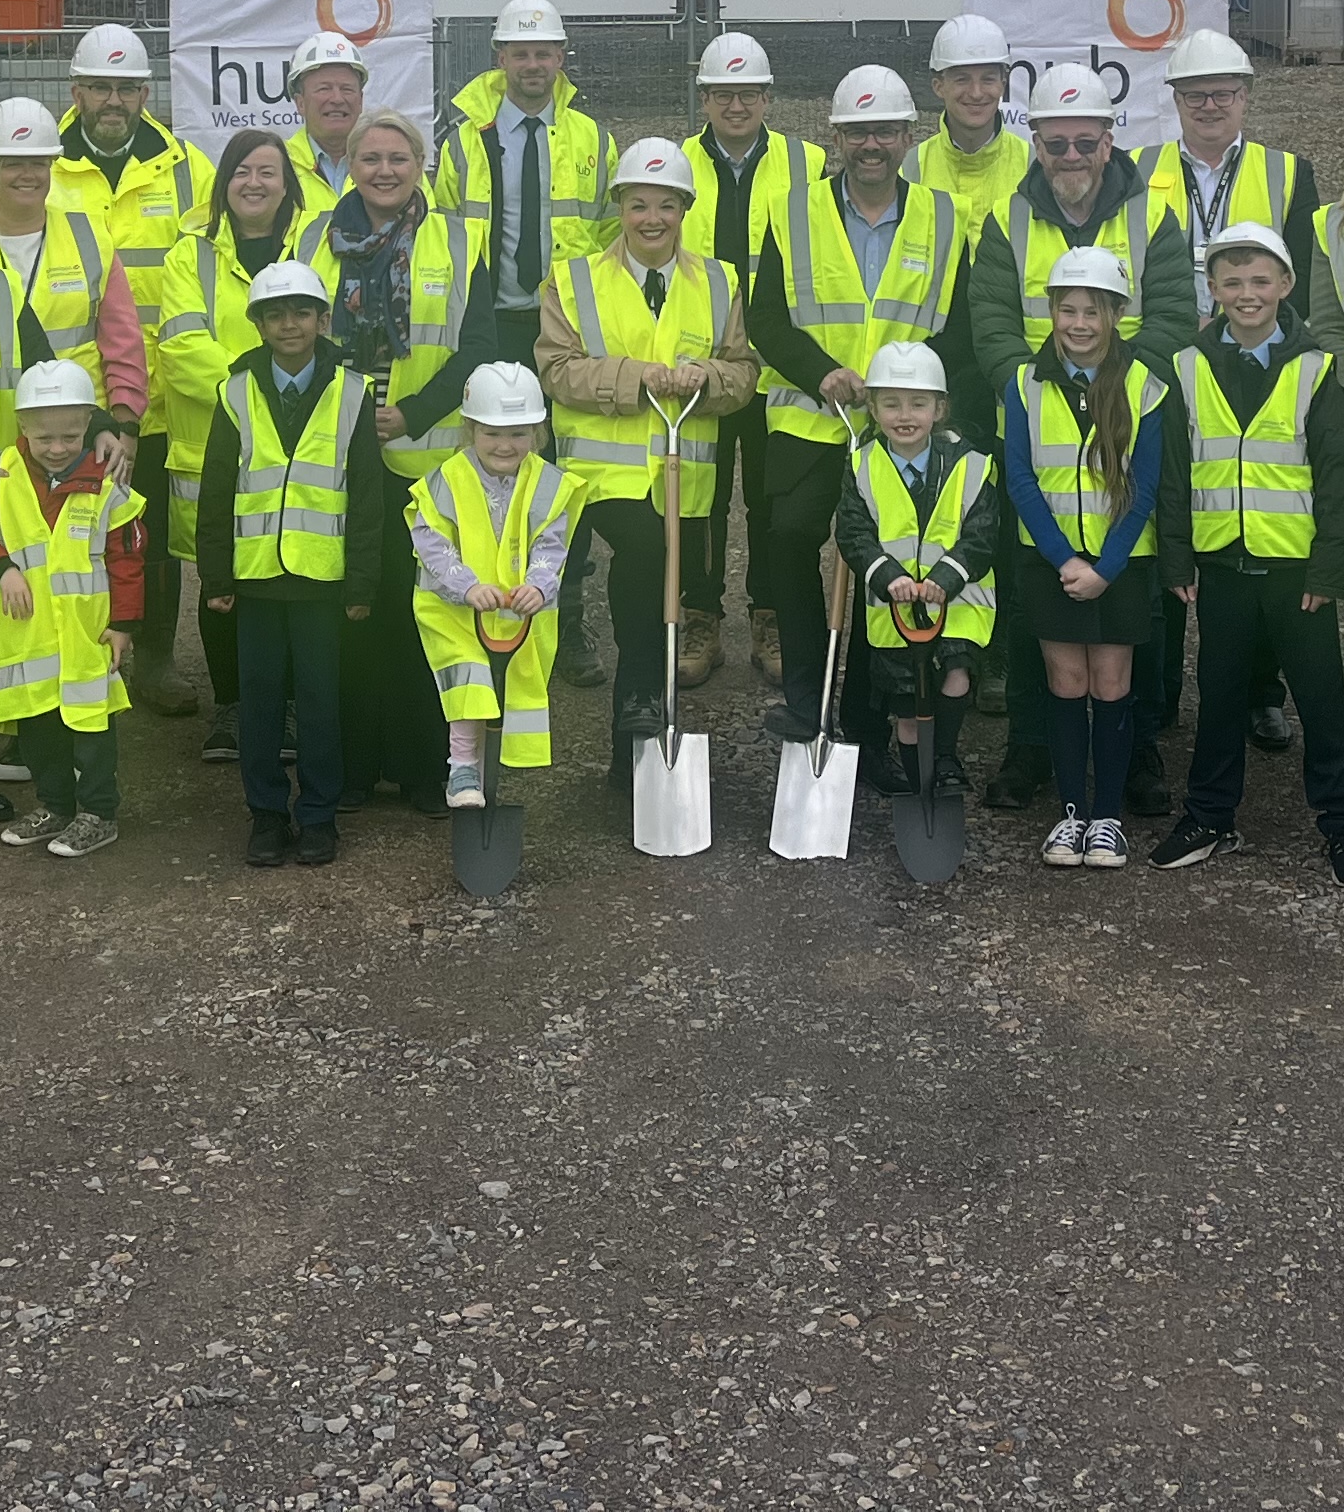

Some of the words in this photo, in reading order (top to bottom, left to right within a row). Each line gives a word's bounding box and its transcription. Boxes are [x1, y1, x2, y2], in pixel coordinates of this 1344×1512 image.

[518, 20, 537, 29] hub
[211, 46, 291, 105] hu
[212, 112, 256, 127] West
